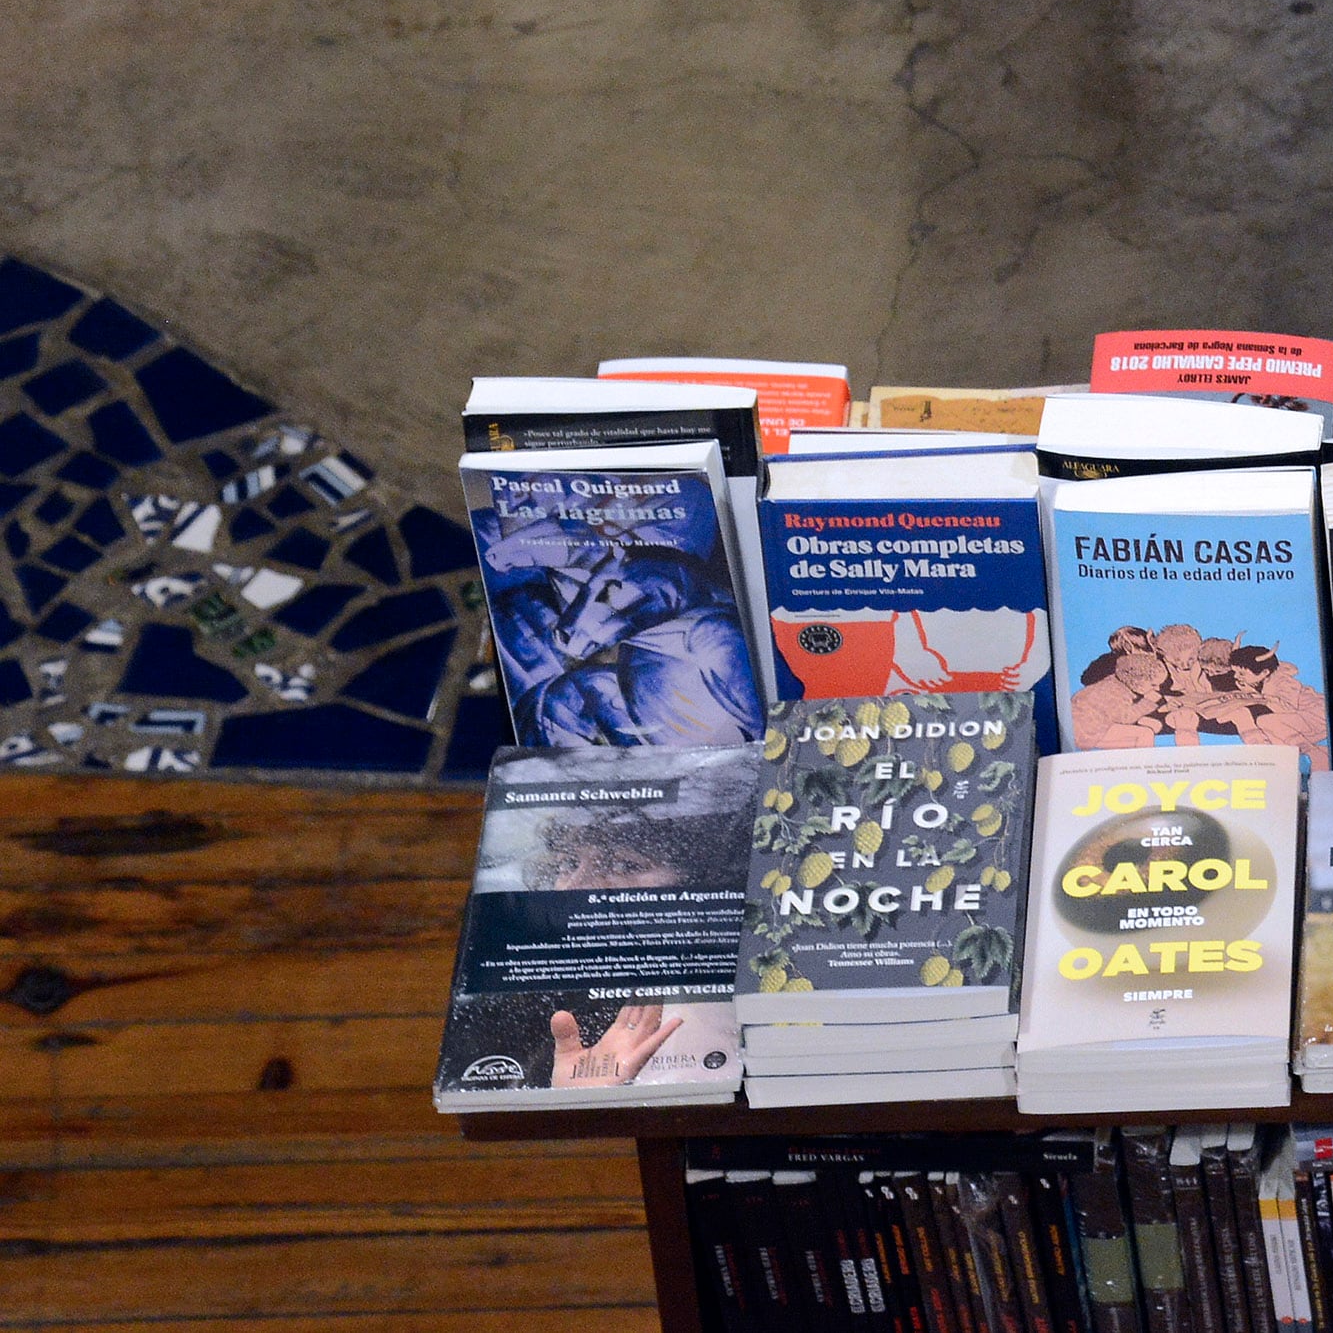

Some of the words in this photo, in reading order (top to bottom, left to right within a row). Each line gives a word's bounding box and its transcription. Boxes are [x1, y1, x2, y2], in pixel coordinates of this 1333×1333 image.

[1134, 342, 1184, 351] Barcelona
[1203, 341, 1233, 352] Negra
[1237, 343, 1275, 354] Semana
[1111, 356, 1149, 371] 2018
[1153, 355, 1224, 370] CARVALHO
[1228, 356, 1262, 372] PEPE
[1266, 358, 1322, 378] PREMIO
[492, 476, 564, 493] Pascal
[570, 479, 681, 497] Quignard
[497, 499, 547, 519] Las
[558, 502, 687, 526] lágrimas
[784, 513, 894, 532] Raymond
[898, 514, 1001, 529] Queneau
[786, 535, 873, 555] Obras
[876, 535, 1025, 559] completas
[1075, 533, 1184, 563] FABIÁN
[1194, 539, 1293, 564] CASAS
[789, 560, 825, 579] de
[829, 559, 898, 583] Sally
[903, 559, 976, 578] Mara
[1078, 564, 1135, 580] Diarios
[1139, 566, 1158, 580] de
[1164, 567, 1177, 580] la
[1184, 567, 1222, 581] edad
[1227, 567, 1251, 581] del
[1256, 570, 1294, 583] pavo
[797, 725, 880, 742] JOAN
[893, 720, 1003, 740] DIDION
[875, 762, 915, 779] EL
[504, 791, 576, 803] Samanta
[579, 787, 664, 801] Schweblin
[1072, 779, 1267, 816] JOYCE
[831, 797, 949, 831] RÍO
[1141, 835, 1193, 847] CERCA
[1062, 858, 1268, 897] CAROL
[609, 891, 658, 903] edición
[679, 890, 745, 903] Argentina
[779, 883, 982, 915] NOCHE
[1151, 906, 1198, 917] TODO
[1119, 916, 1205, 930] MOMENTO
[828, 959, 873, 968] Tennessee
[875, 958, 914, 966] Williams
[1058, 940, 1264, 980] OATES
[588, 987, 632, 1000] Siete
[635, 987, 680, 997] casas
[1123, 989, 1193, 1002] SIEMPRE
[788, 1153, 818, 1163] FRED
[821, 1153, 865, 1163] VARGAS
